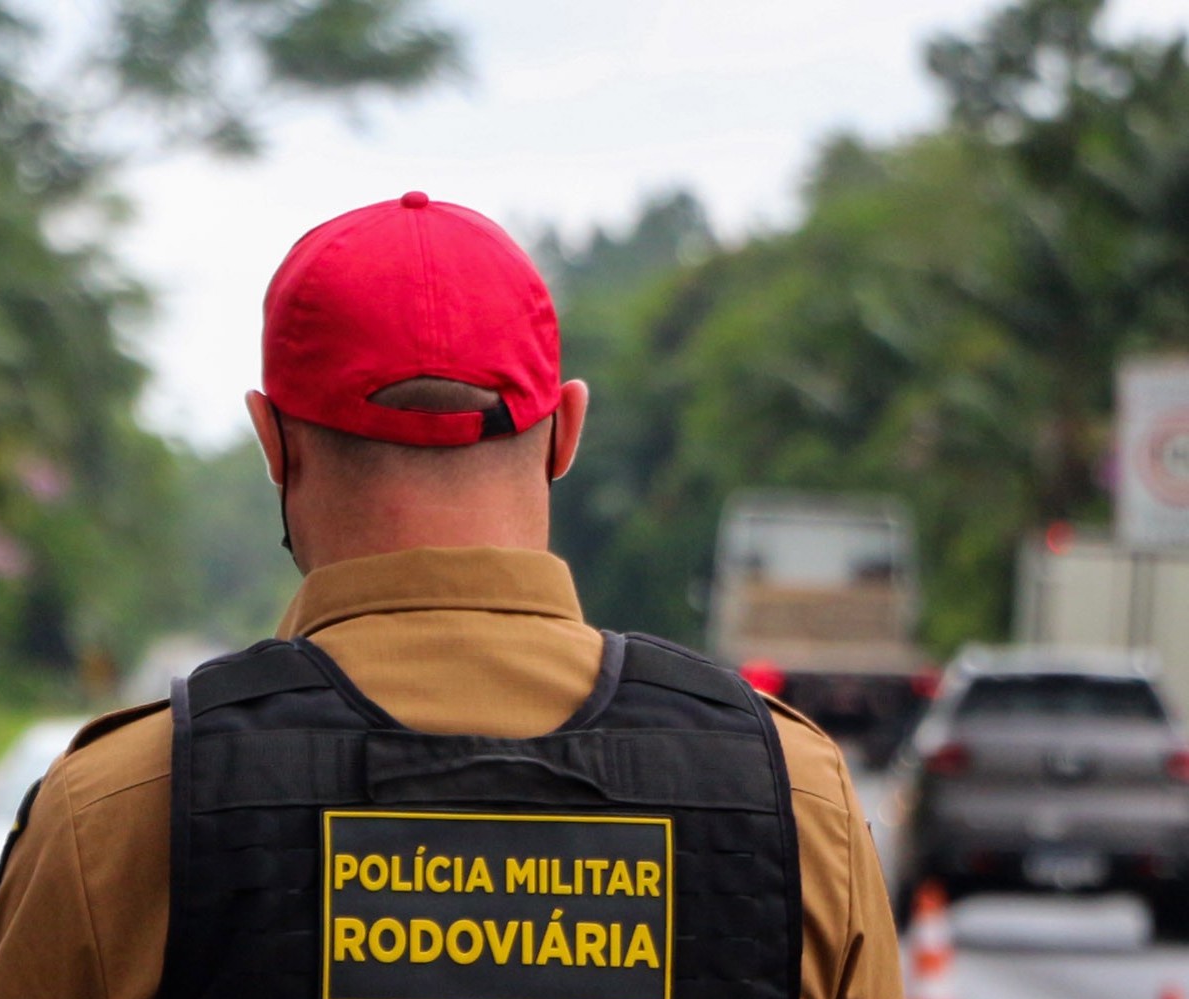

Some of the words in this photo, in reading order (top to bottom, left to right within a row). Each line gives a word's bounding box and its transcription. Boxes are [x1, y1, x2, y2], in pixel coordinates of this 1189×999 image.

[334, 846, 495, 893] POLÍCIA
[505, 858, 661, 897] MILITAR
[334, 908, 661, 969] RODOVIÁRIA
